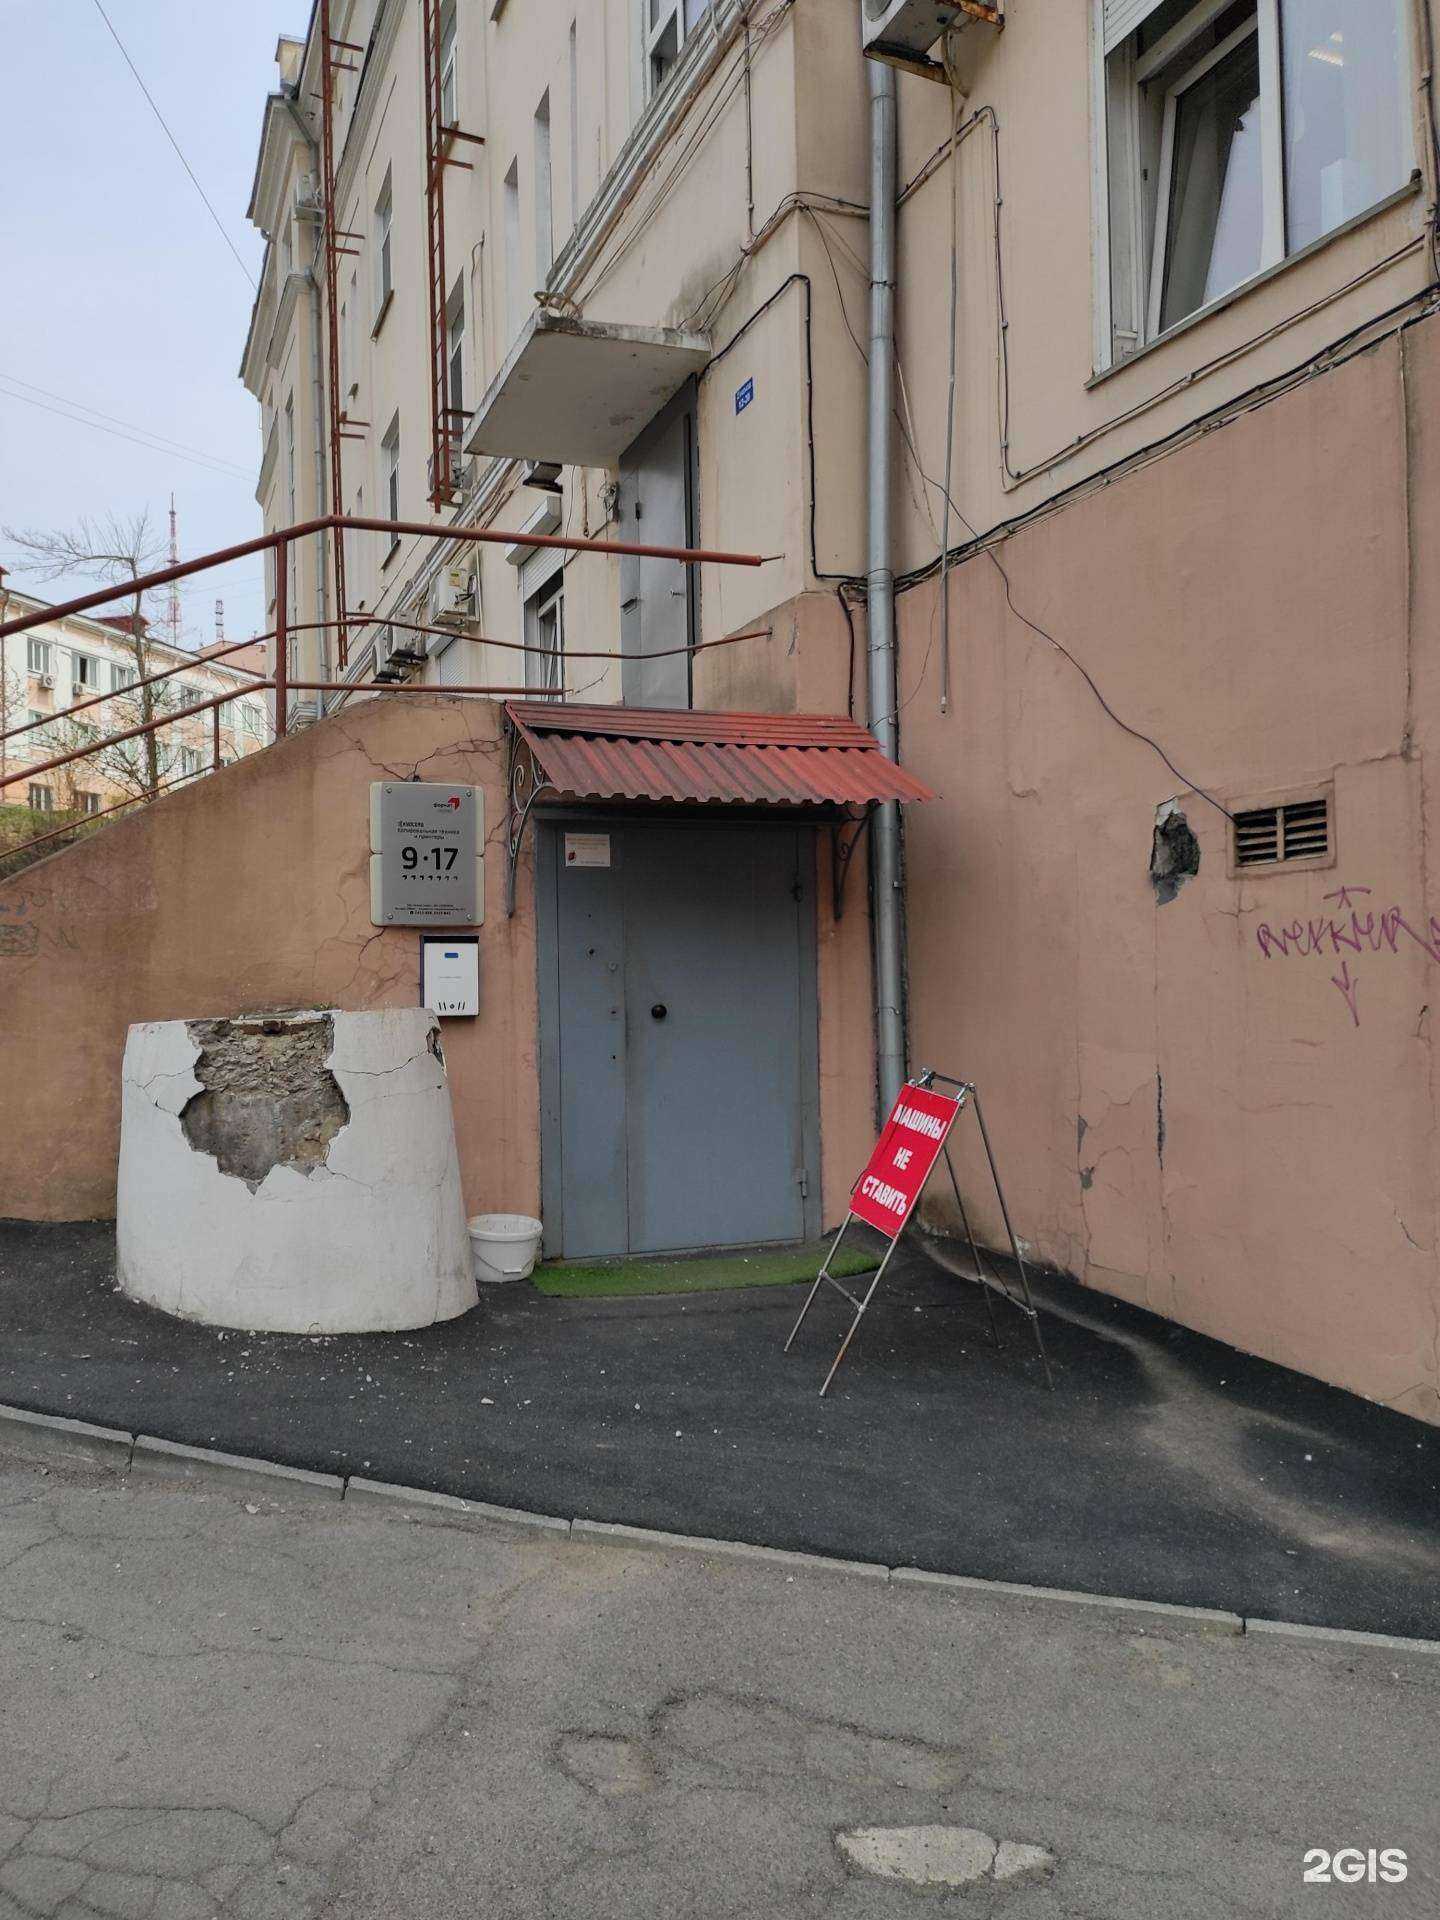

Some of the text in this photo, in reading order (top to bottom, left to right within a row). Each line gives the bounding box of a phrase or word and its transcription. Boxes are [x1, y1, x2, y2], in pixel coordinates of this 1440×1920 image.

[892, 1104, 947, 1140] МАШИНЫ
[892, 1147, 913, 1170] НЕ
[861, 1175, 907, 1216] СТАВИТЬ
